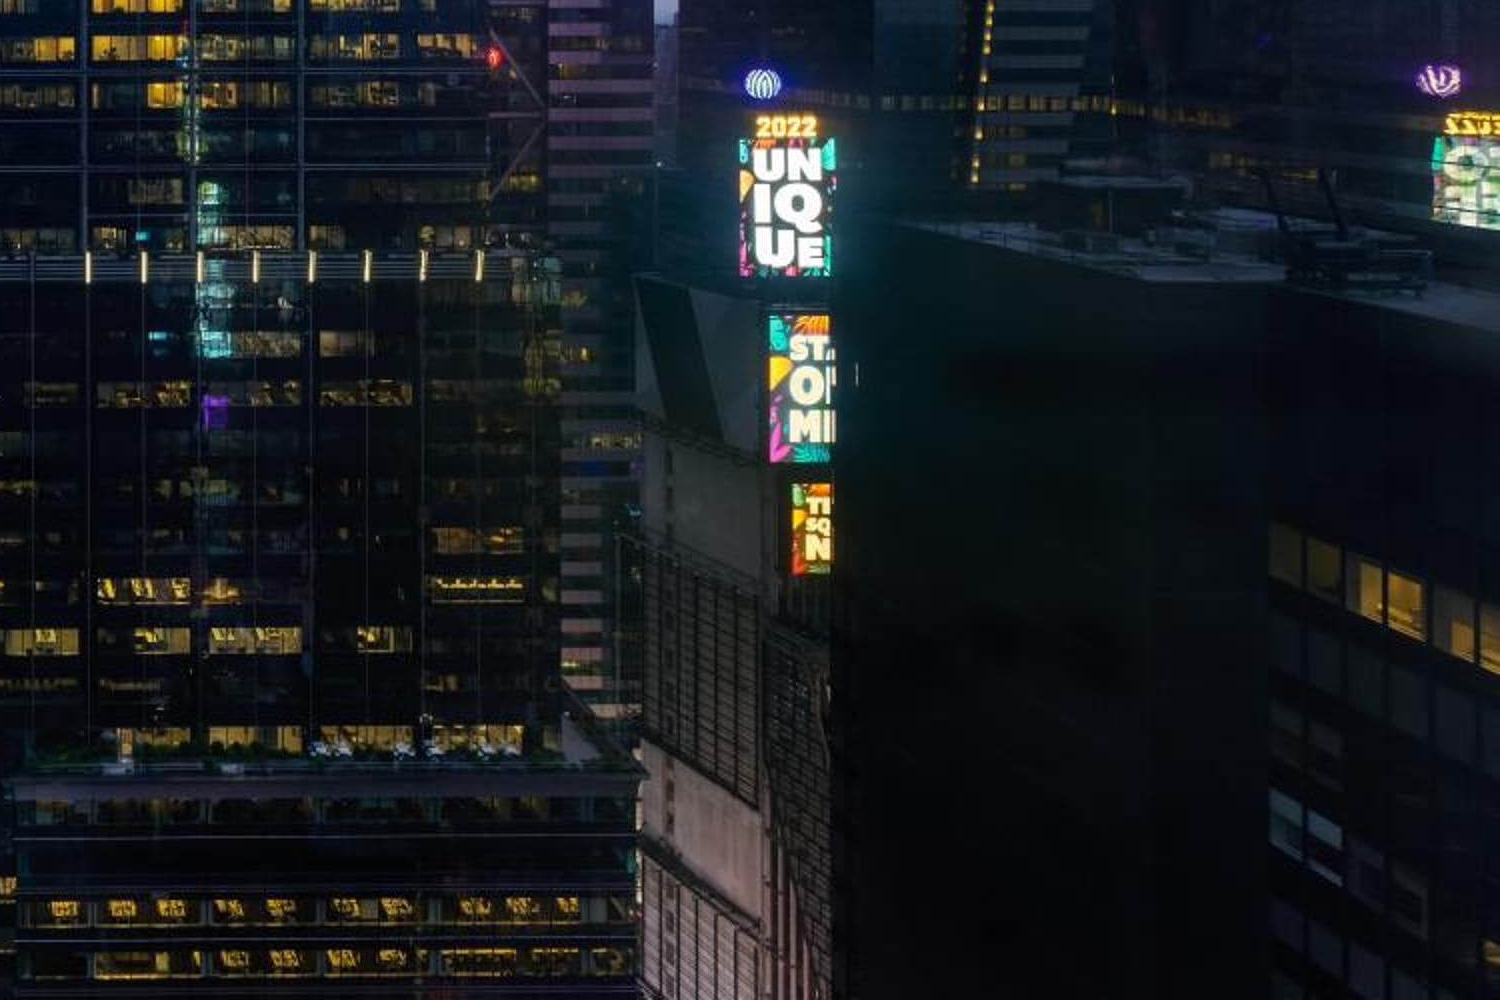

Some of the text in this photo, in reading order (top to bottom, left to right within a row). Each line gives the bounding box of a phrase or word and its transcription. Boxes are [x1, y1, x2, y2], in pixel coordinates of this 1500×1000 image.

[755, 114, 818, 139] 2022
[753, 147, 823, 182] UN
[754, 183, 824, 234] IQ
[754, 226, 824, 268] UE
